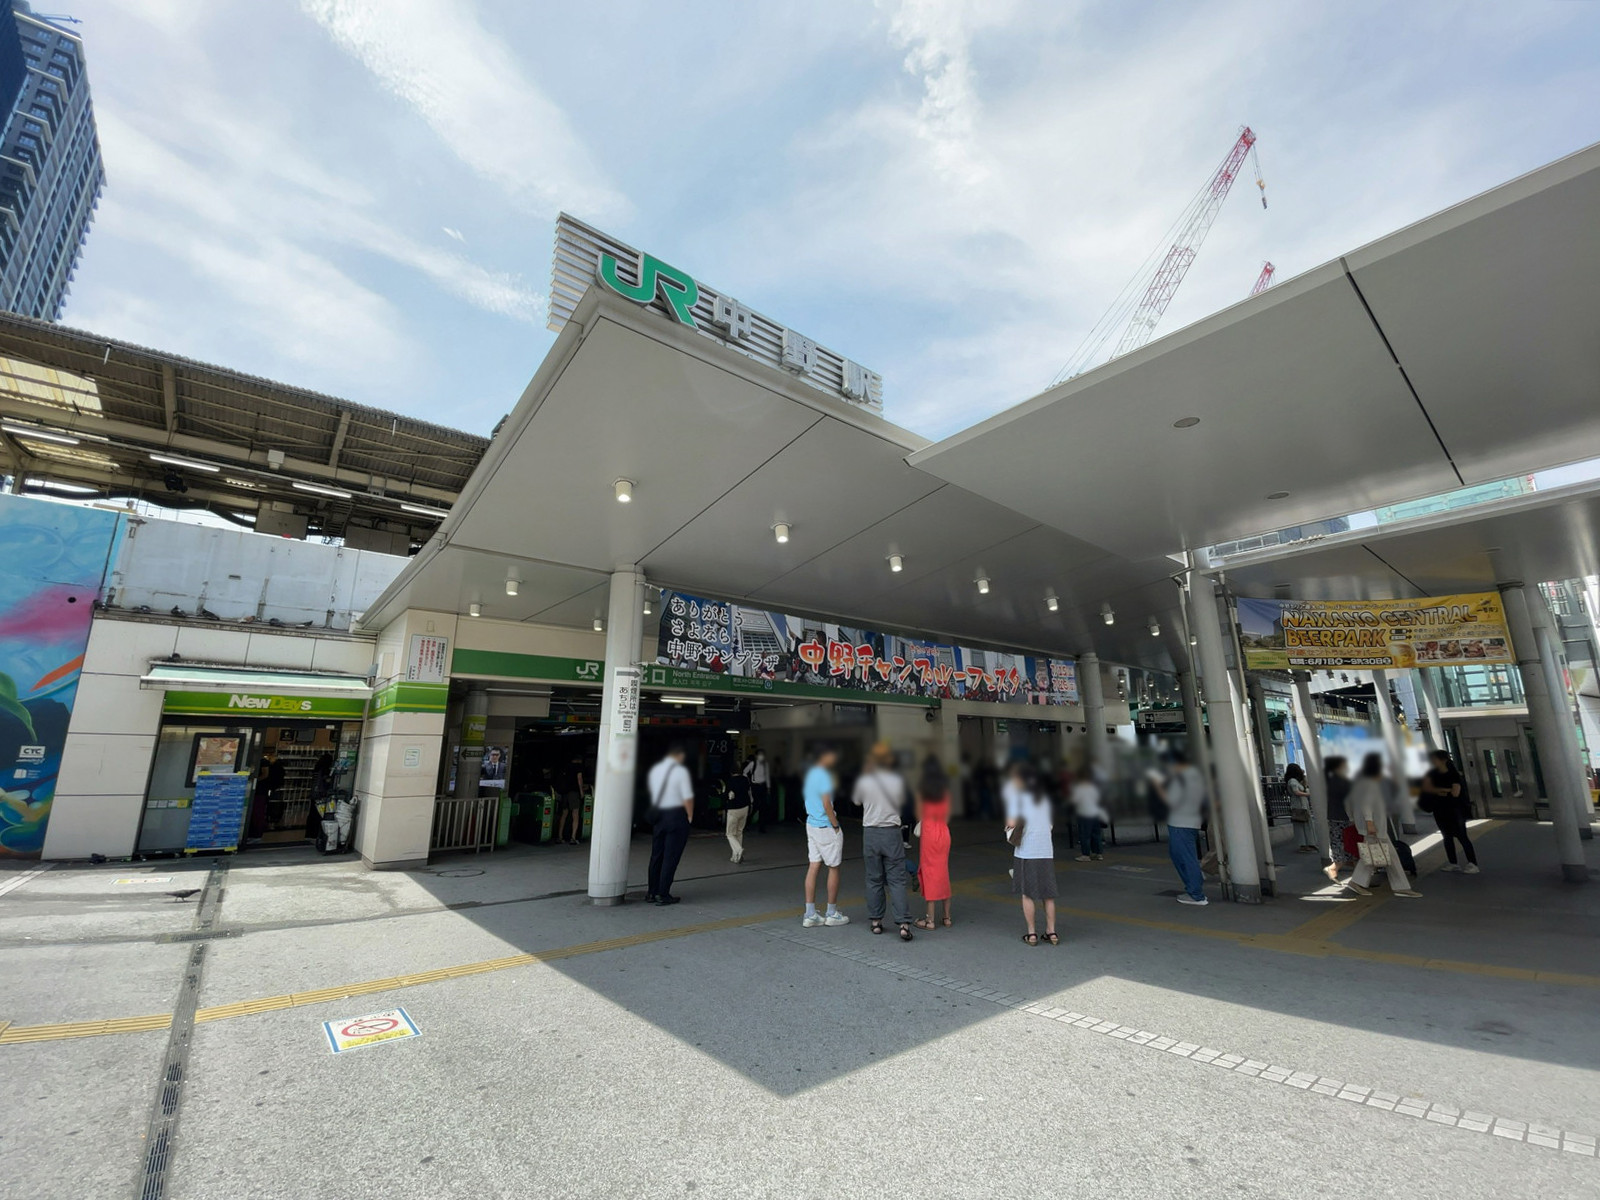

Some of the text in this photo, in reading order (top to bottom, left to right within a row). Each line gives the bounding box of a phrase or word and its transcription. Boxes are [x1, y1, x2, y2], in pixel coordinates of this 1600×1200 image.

[595, 251, 874, 405] JR 中野駅
[671, 597, 744, 626] ありがとう
[1281, 604, 1478, 628] NAKANO CENTRAL
[671, 618, 730, 644] さよなら
[1285, 628, 1386, 648] BEERPARK
[667, 638, 779, 672] 中野サンプラザ
[798, 638, 1021, 696] 中野チャンプルーフェスタ
[576, 661, 599, 675] JR
[672, 670, 720, 680] North Entrance
[228, 694, 312, 711] NewDays
[619, 686, 628, 710] あちら
